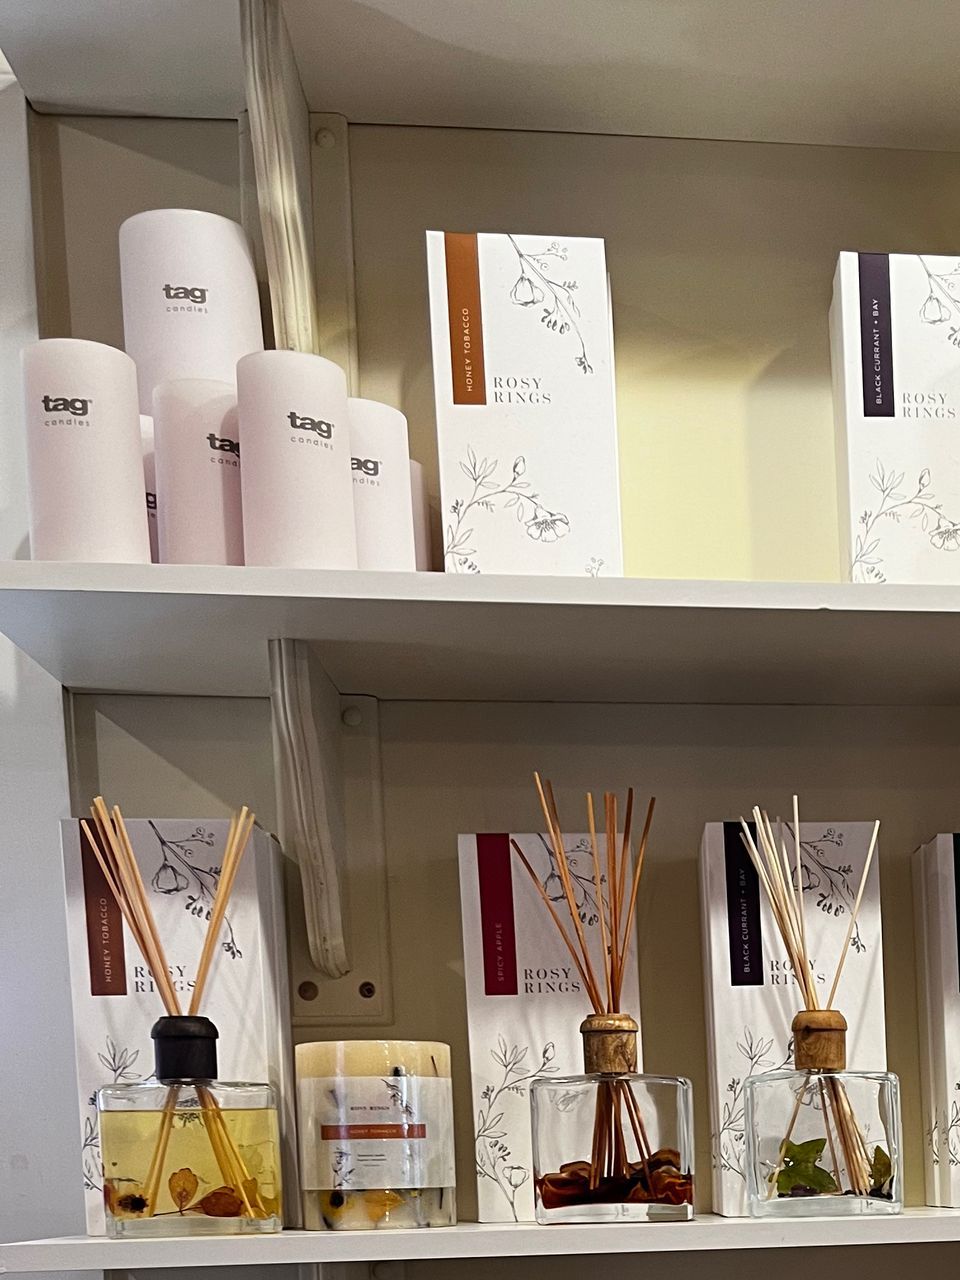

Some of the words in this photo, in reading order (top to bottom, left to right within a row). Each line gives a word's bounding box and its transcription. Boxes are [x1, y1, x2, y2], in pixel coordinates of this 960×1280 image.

[163, 284, 207, 303] tag
[166, 305, 208, 314] candles
[461, 307, 471, 354] TOBACCO
[872, 328, 881, 372] CURRANT
[464, 358, 473, 392] HONEY
[493, 376, 542, 389] ROSY
[493, 391, 552, 404] RINGS
[874, 374, 883, 405] BLACK
[902, 392, 947, 405] ROSY
[42, 395, 89, 416] tag
[902, 406, 957, 419] RINGS
[44, 418, 90, 427] candles
[287, 411, 333, 440] tag
[290, 436, 334, 450] candles
[351, 456, 379, 476] ag
[352, 477, 380, 487] ndles
[739, 868, 747, 888] BAY
[101, 897, 111, 945] TOBACCO
[739, 898, 750, 941] CURRANT
[104, 948, 112, 983] HONEY
[497, 955, 505, 981] SPICY
[743, 942, 751, 974] BLACK
[524, 968, 572, 980] ROSY
[134, 980, 196, 993] RIGS
[524, 981, 581, 994] RINGS
